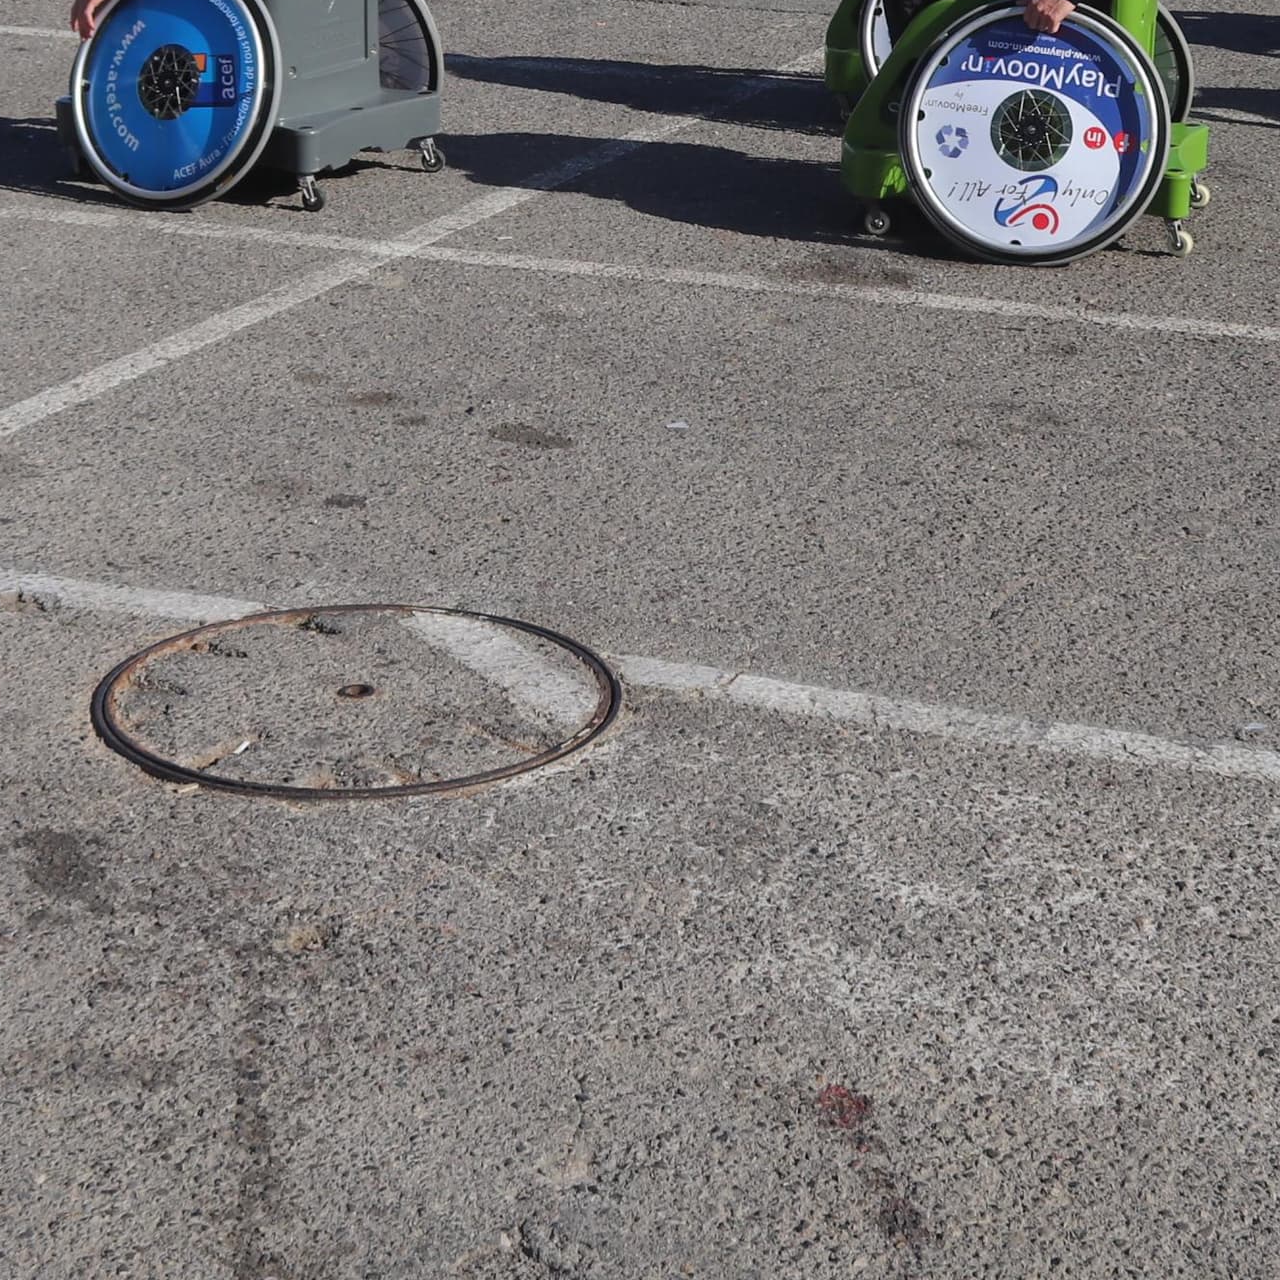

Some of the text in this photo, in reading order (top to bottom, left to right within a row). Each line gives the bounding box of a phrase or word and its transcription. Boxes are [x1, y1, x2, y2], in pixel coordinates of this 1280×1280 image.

[235, 25, 247, 41] les
[240, 40, 253, 64] tous
[988, 40, 1103, 63] www.playmoovin.com
[218, 58, 236, 99] acef
[245, 66, 255, 80] de
[106, 20, 146, 152] www.acef.com
[173, 162, 198, 180] ACEF
[198, 150, 221, 170] Aura
[994, 183, 1029, 206] For
[1061, 179, 1109, 208] Only
